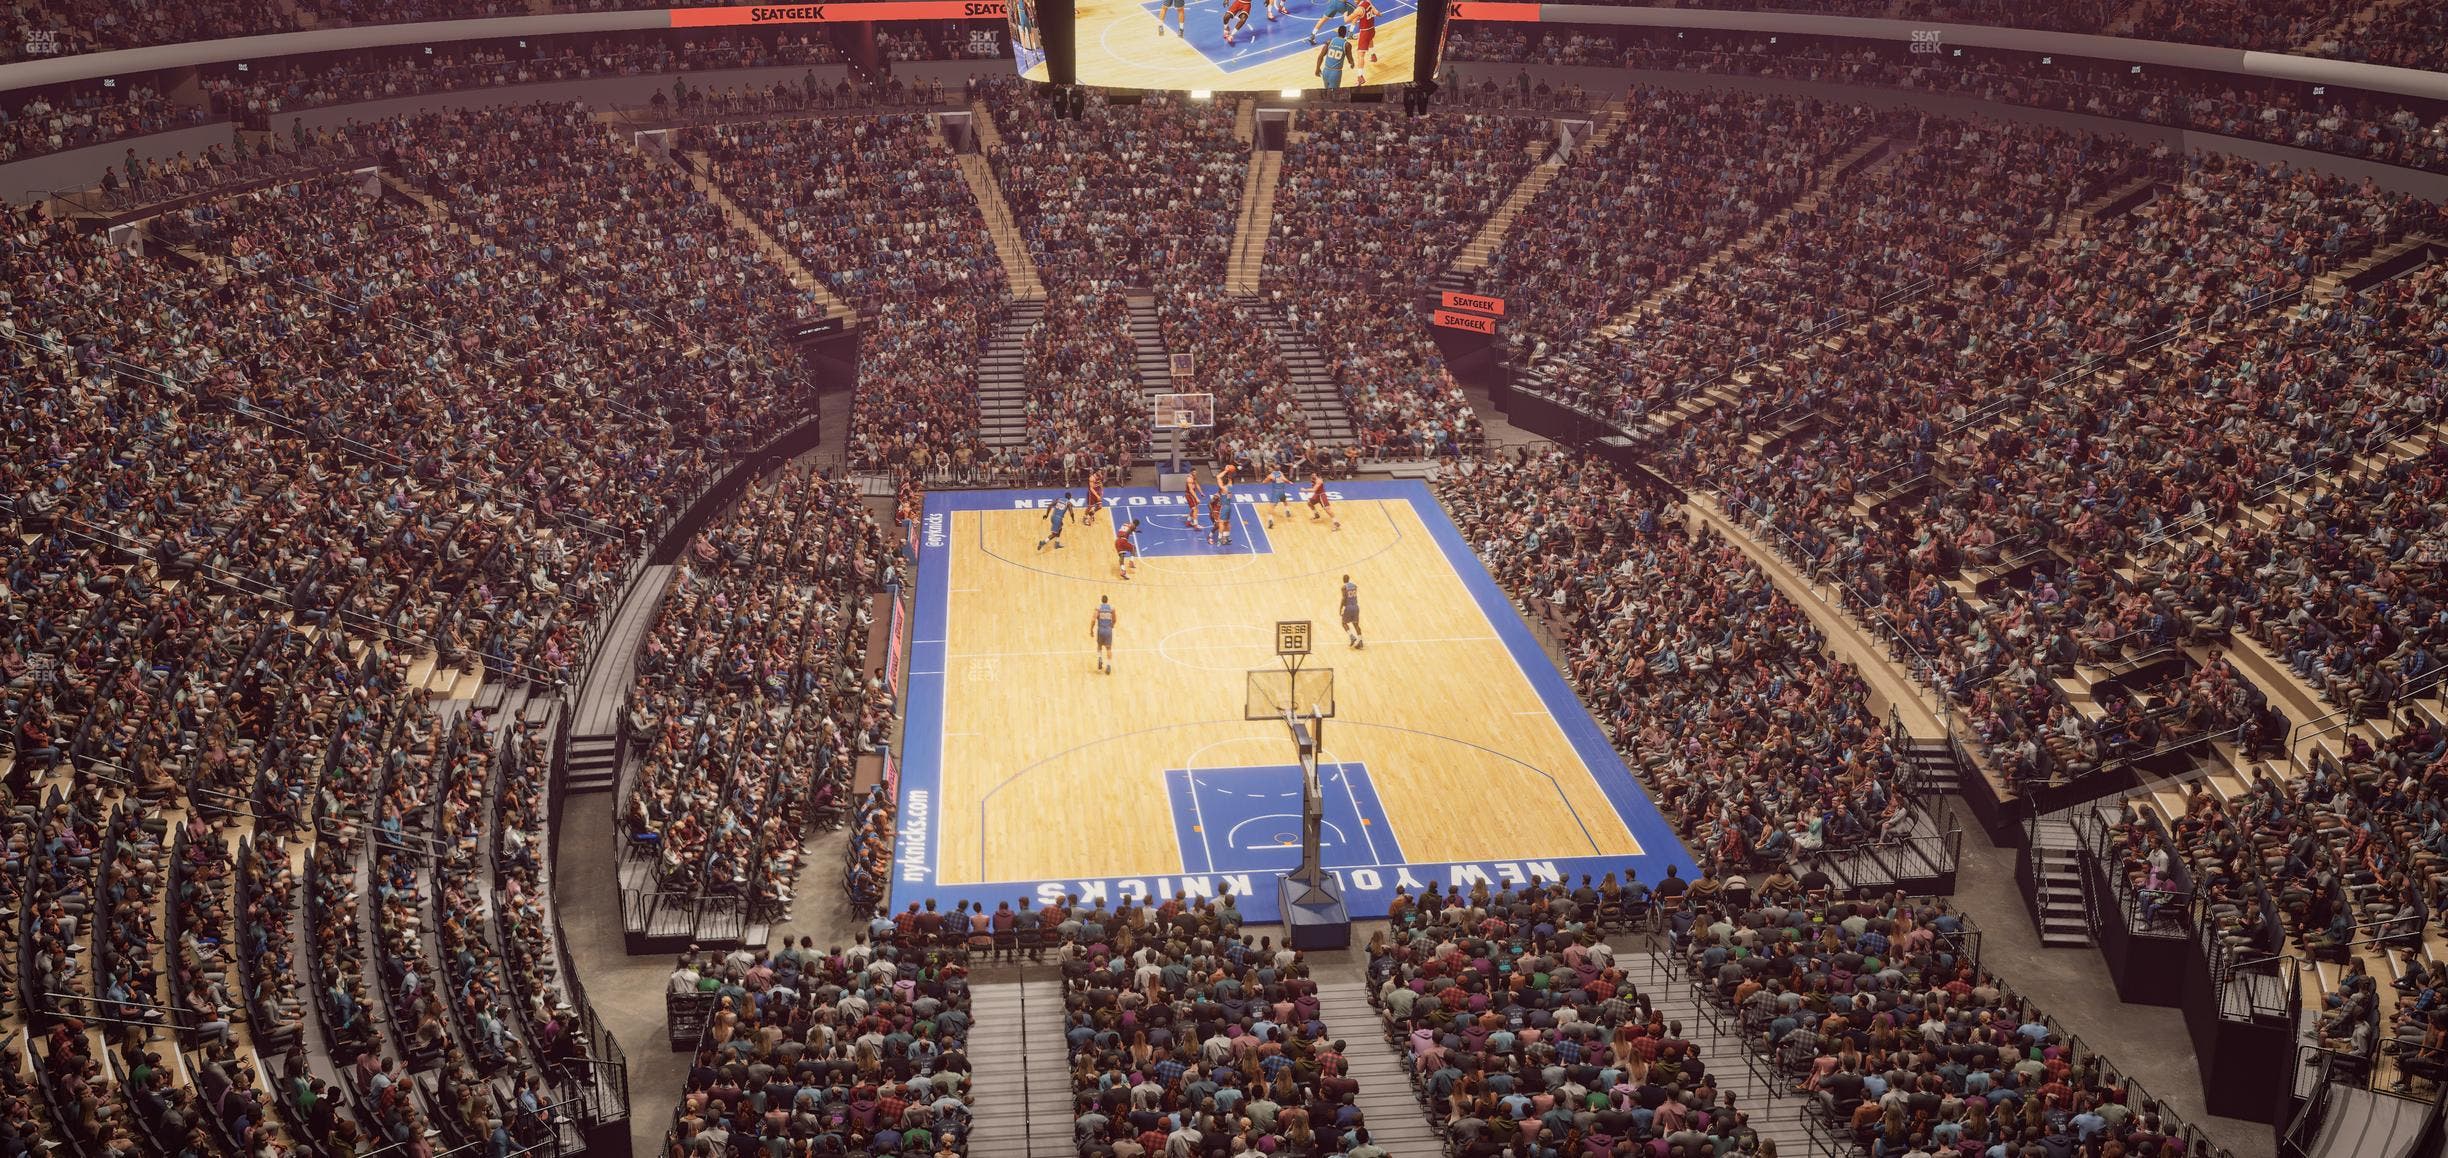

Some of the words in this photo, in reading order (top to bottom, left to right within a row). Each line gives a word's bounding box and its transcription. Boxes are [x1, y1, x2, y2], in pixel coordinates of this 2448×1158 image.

[751, 6, 825, 22] SEATGEEK
[1327, 48, 1343, 60] 00
[1453, 296, 1494, 311] SEATGEEK
[1444, 315, 1486, 331] SEATGEEK
[923, 512, 946, 548] @nyknicks
[1285, 636, 1302, 648] 88
[896, 789, 932, 882] nyknicks.com
[1451, 861, 1561, 886] NEW
[1037, 874, 1253, 905] KNICKS
